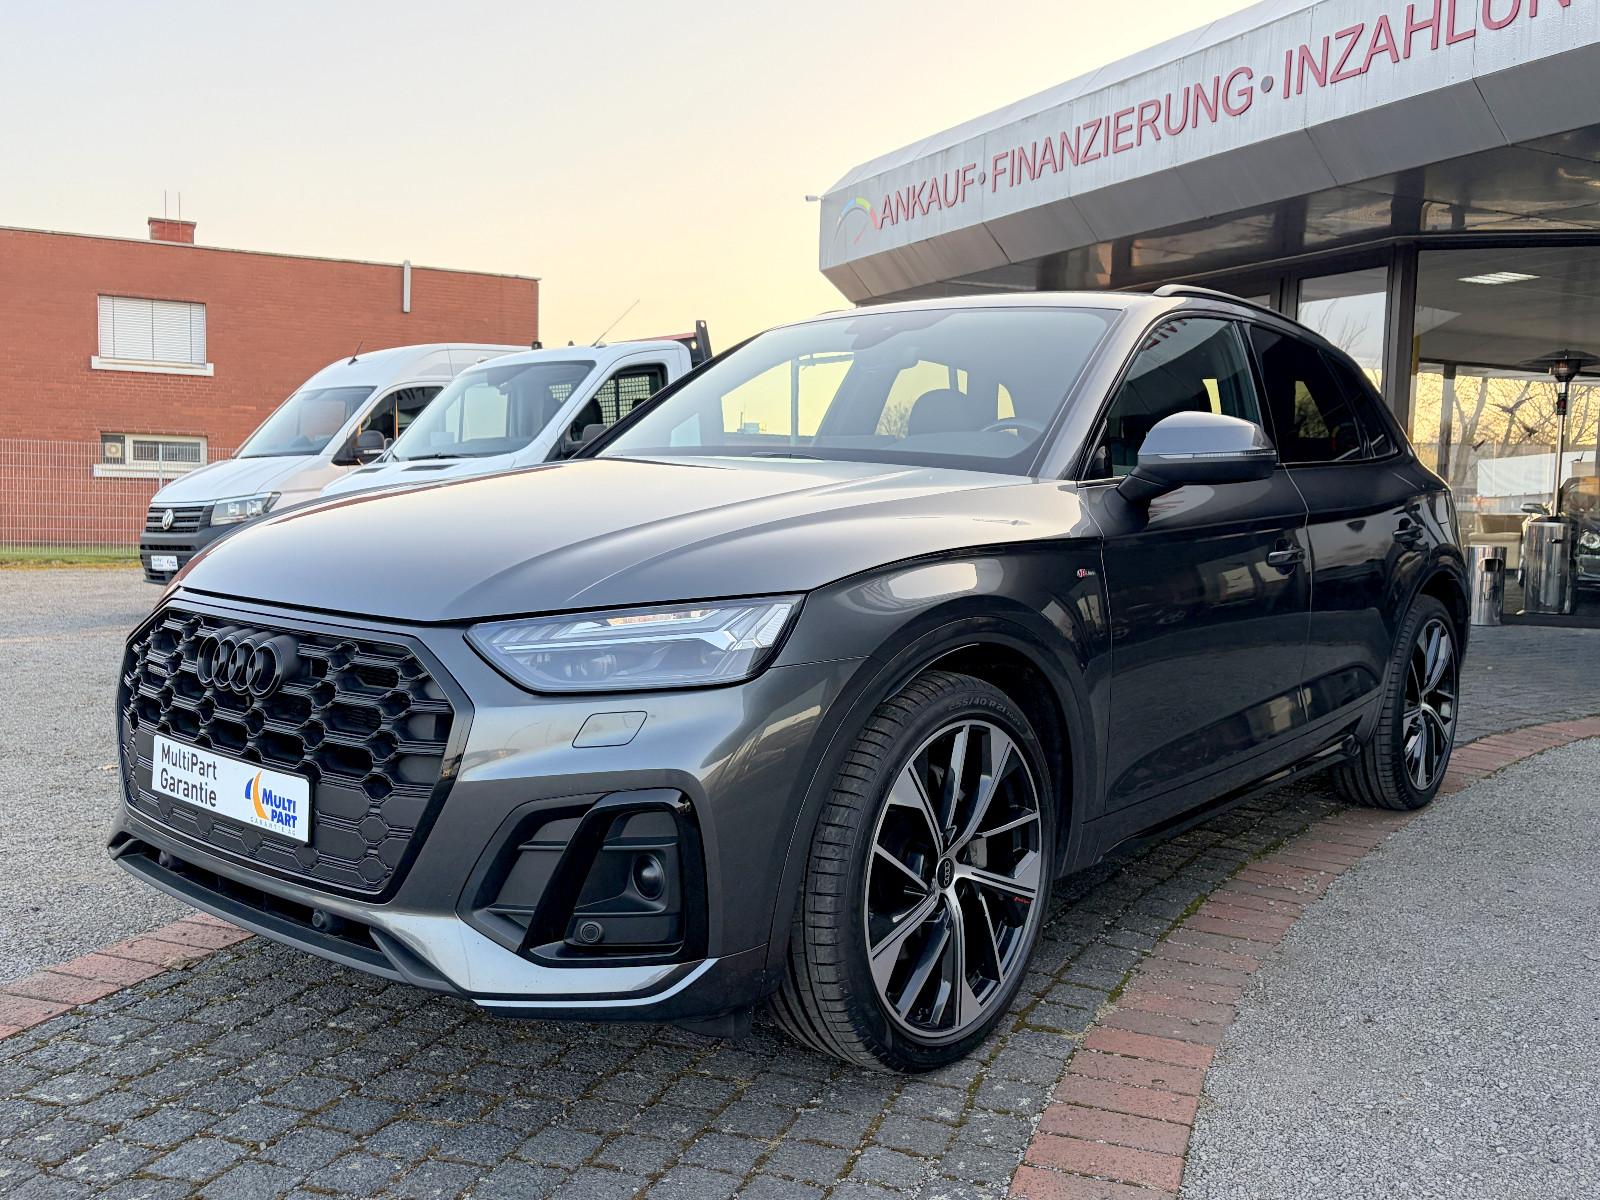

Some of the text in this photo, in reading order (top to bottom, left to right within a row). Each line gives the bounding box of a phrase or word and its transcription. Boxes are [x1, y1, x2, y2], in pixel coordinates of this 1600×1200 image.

[880, 163, 976, 229] ANKAUF
[992, 66, 1254, 193] FINANZIERUNG
[161, 743, 217, 780] MultiPart
[160, 768, 217, 807] Garantie
[271, 808, 297, 829] PART
